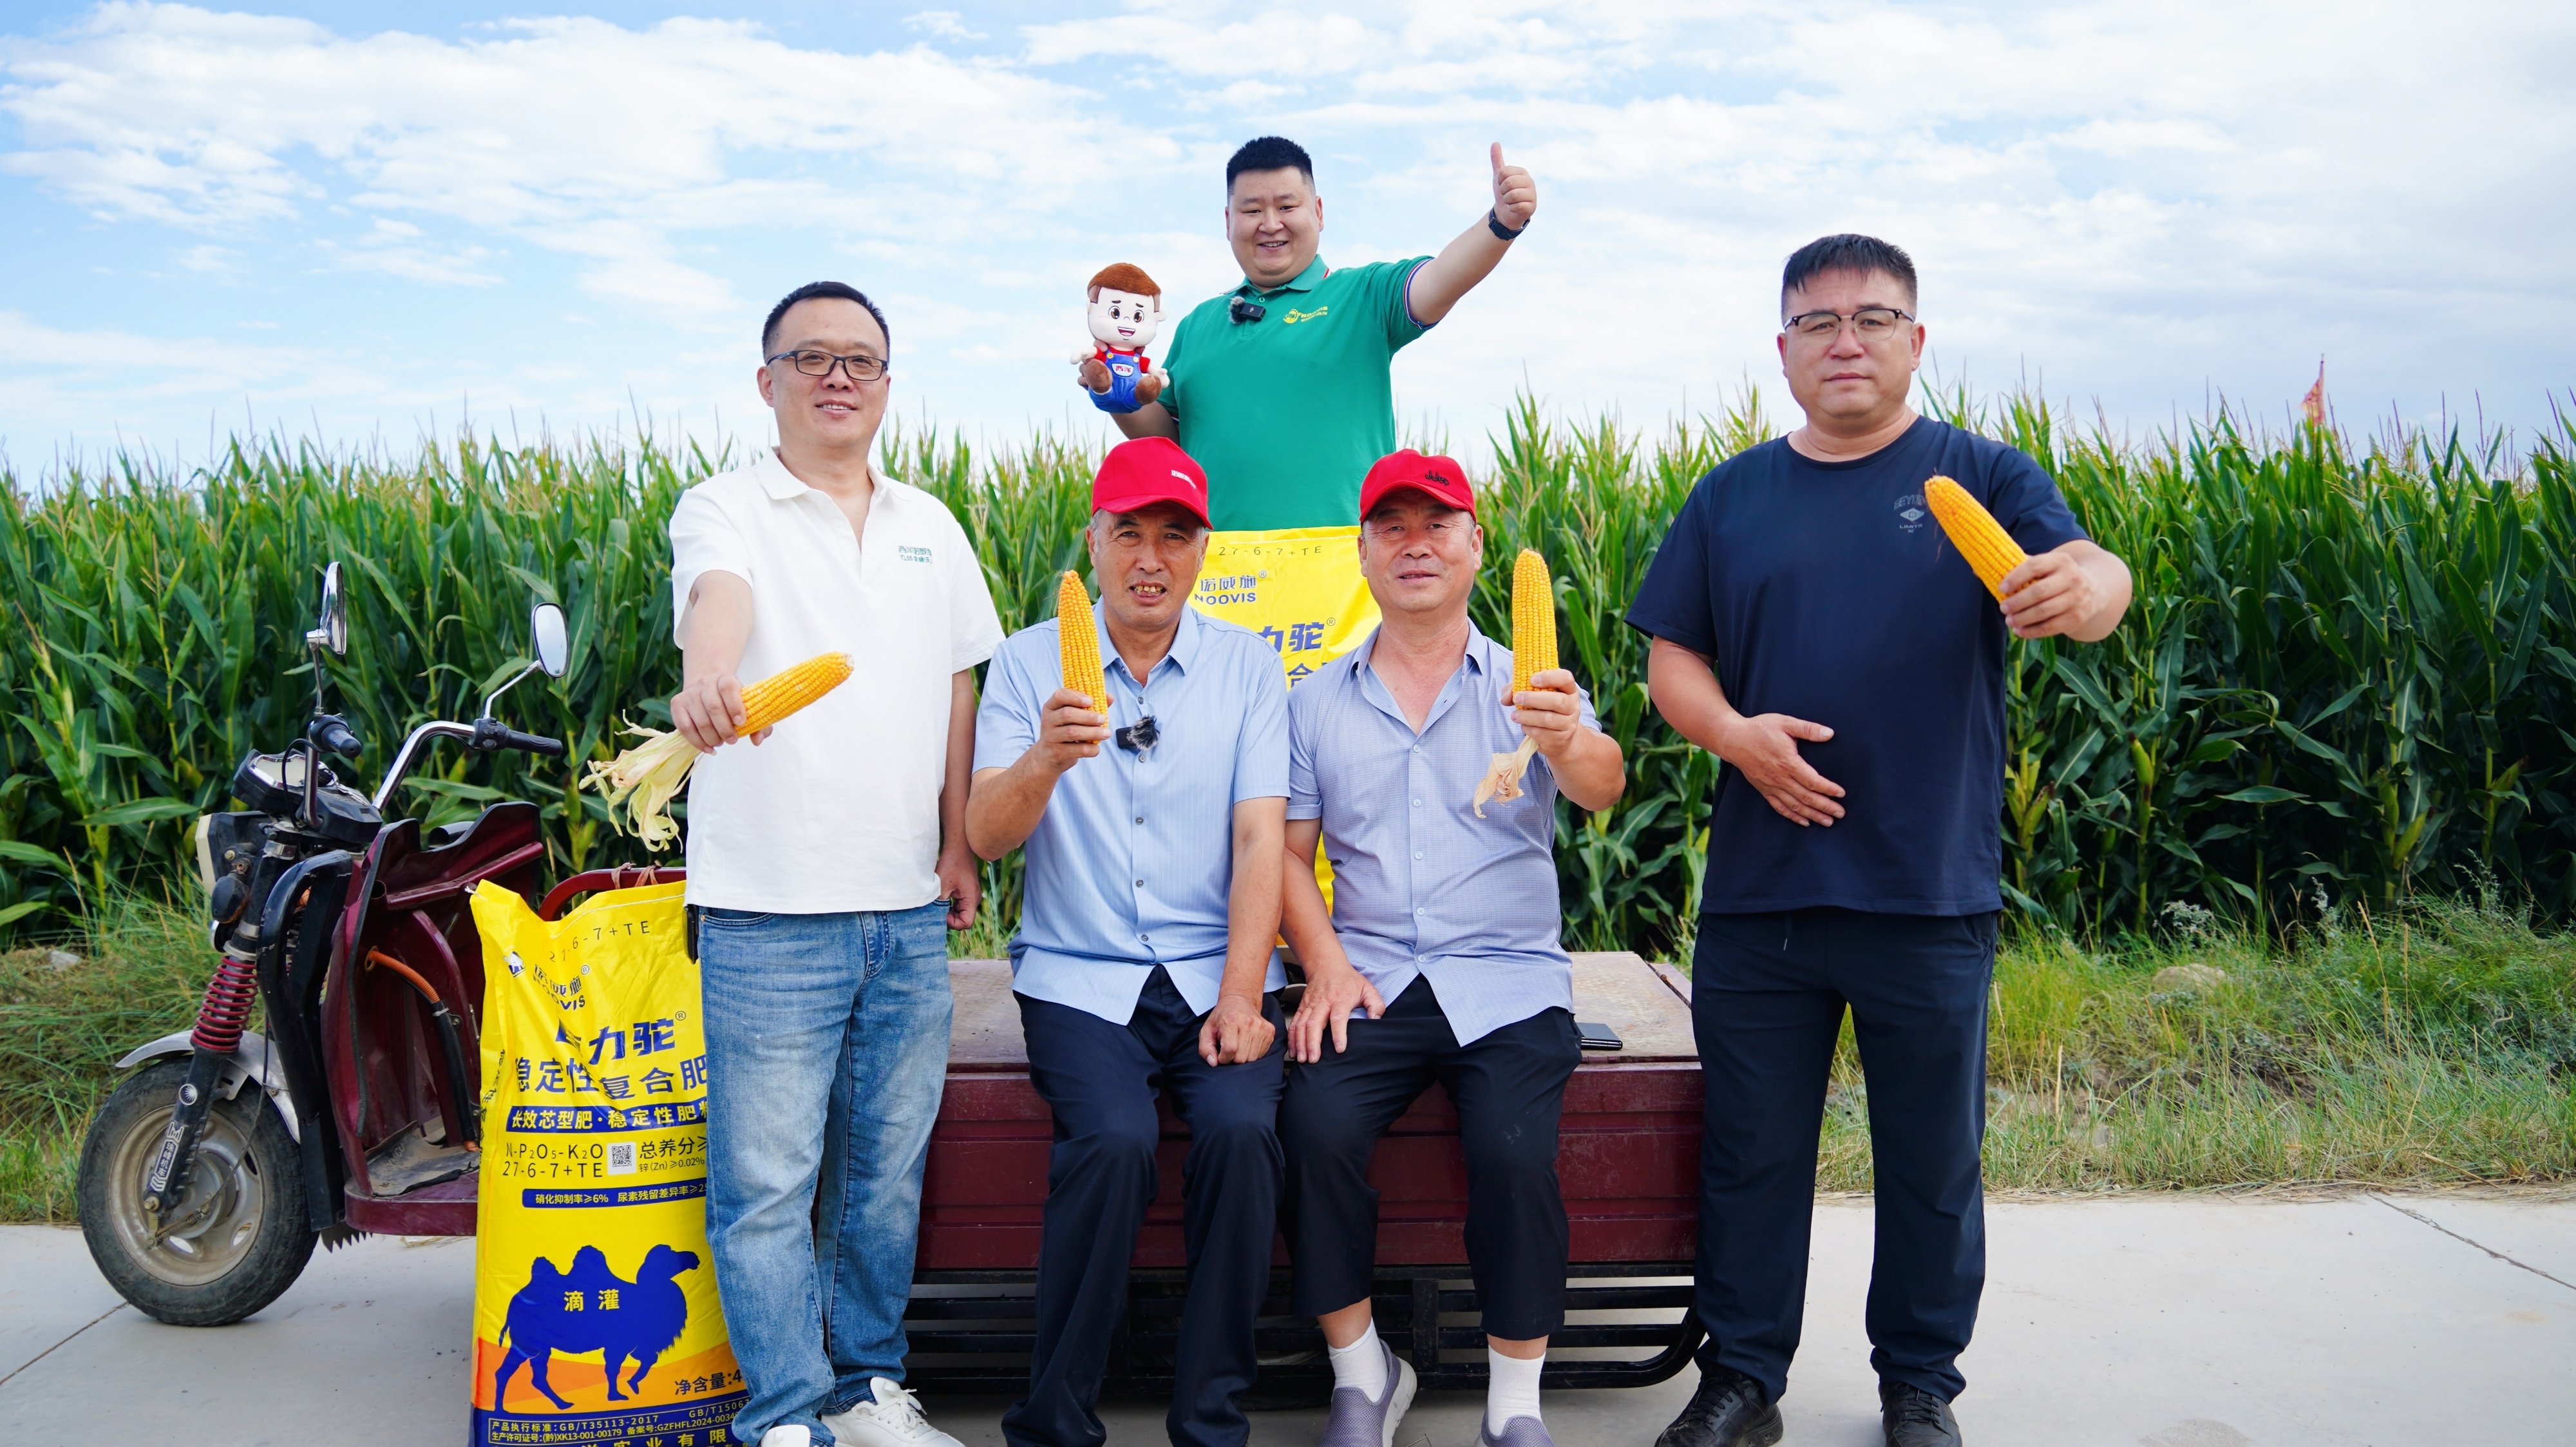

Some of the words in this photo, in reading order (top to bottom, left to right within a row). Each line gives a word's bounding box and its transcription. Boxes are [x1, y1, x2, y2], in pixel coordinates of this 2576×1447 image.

[1218, 545, 1321, 556] 27-6-7+TE
[1194, 592, 1256, 605] NOOVIS
[502, 1161, 603, 1178] 27-6-7+TE
[535, 1193, 609, 1204] 硝化抑制率≥6%
[564, 1289, 620, 1312] 滴灌
